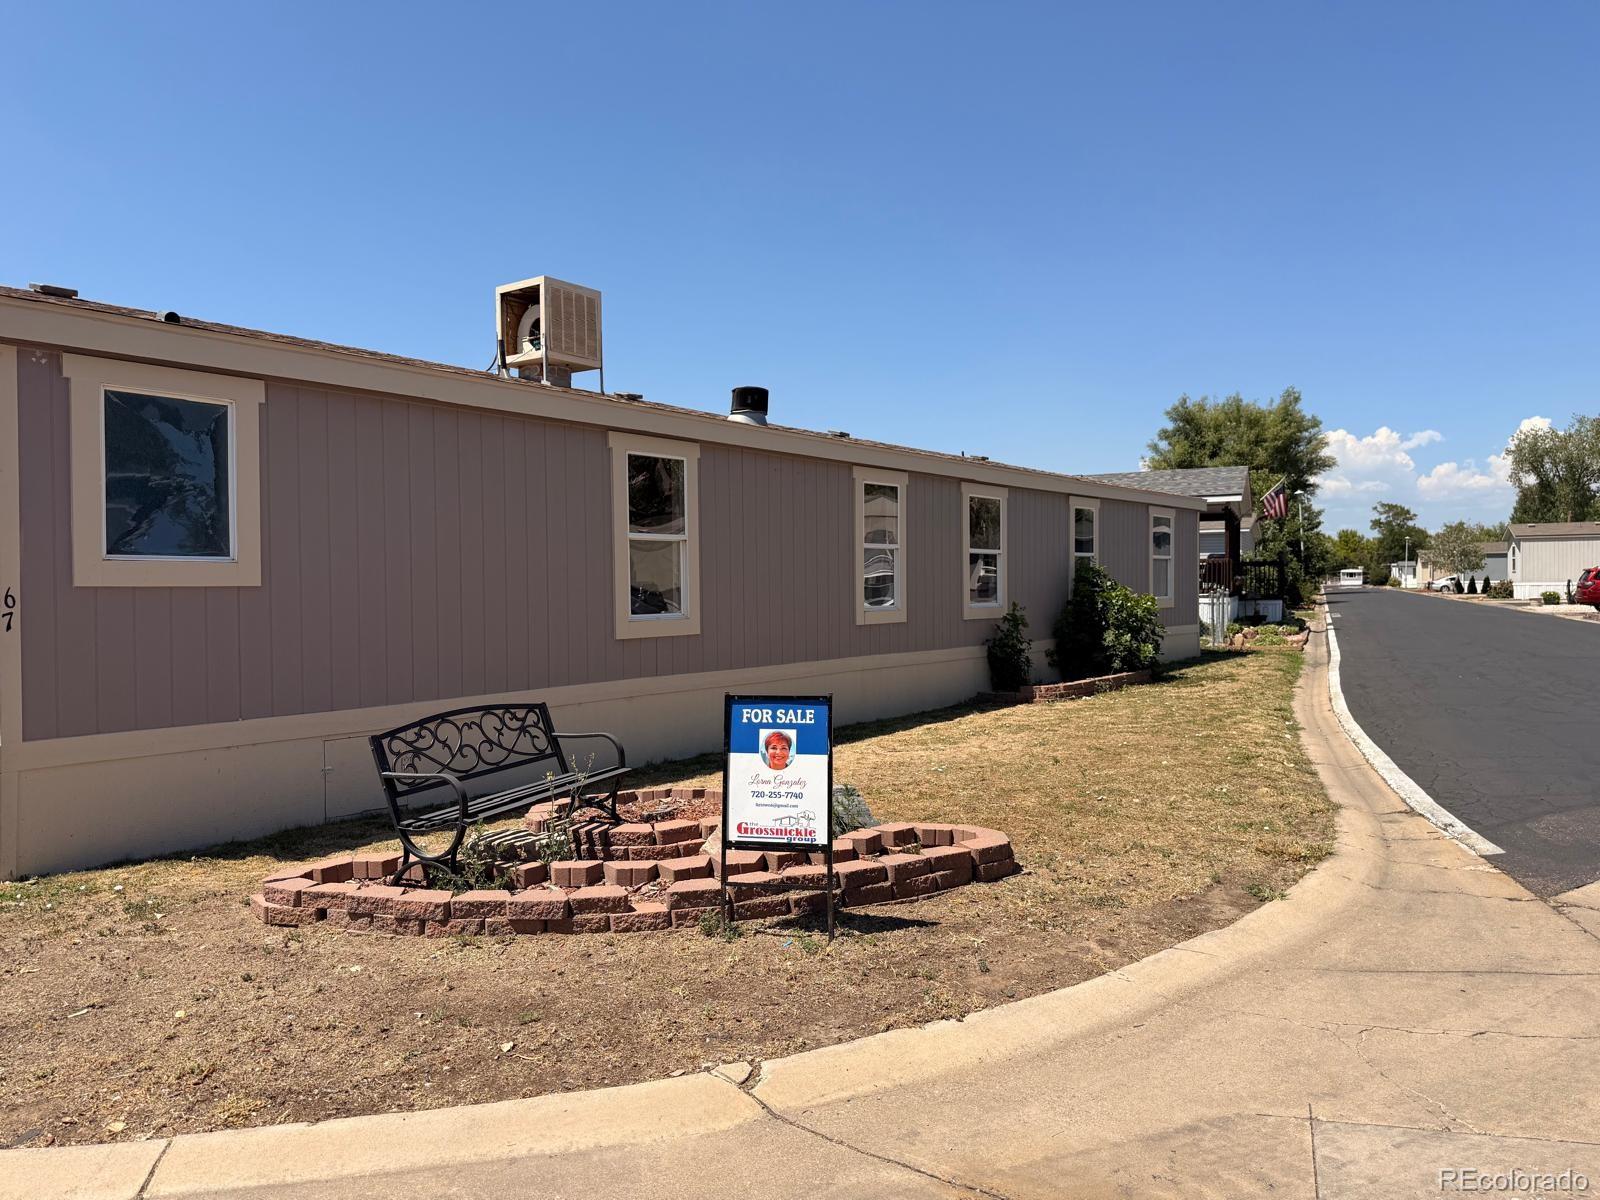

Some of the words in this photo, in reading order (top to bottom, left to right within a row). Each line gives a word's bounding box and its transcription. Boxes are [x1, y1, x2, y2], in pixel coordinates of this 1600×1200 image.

[1, 586, 16, 632] 67
[742, 708, 773, 724] FOR
[776, 709, 815, 724] SALE
[751, 790, 804, 800] 720-255-7740
[736, 821, 817, 838] Grossnickle
[786, 836, 817, 844] group
